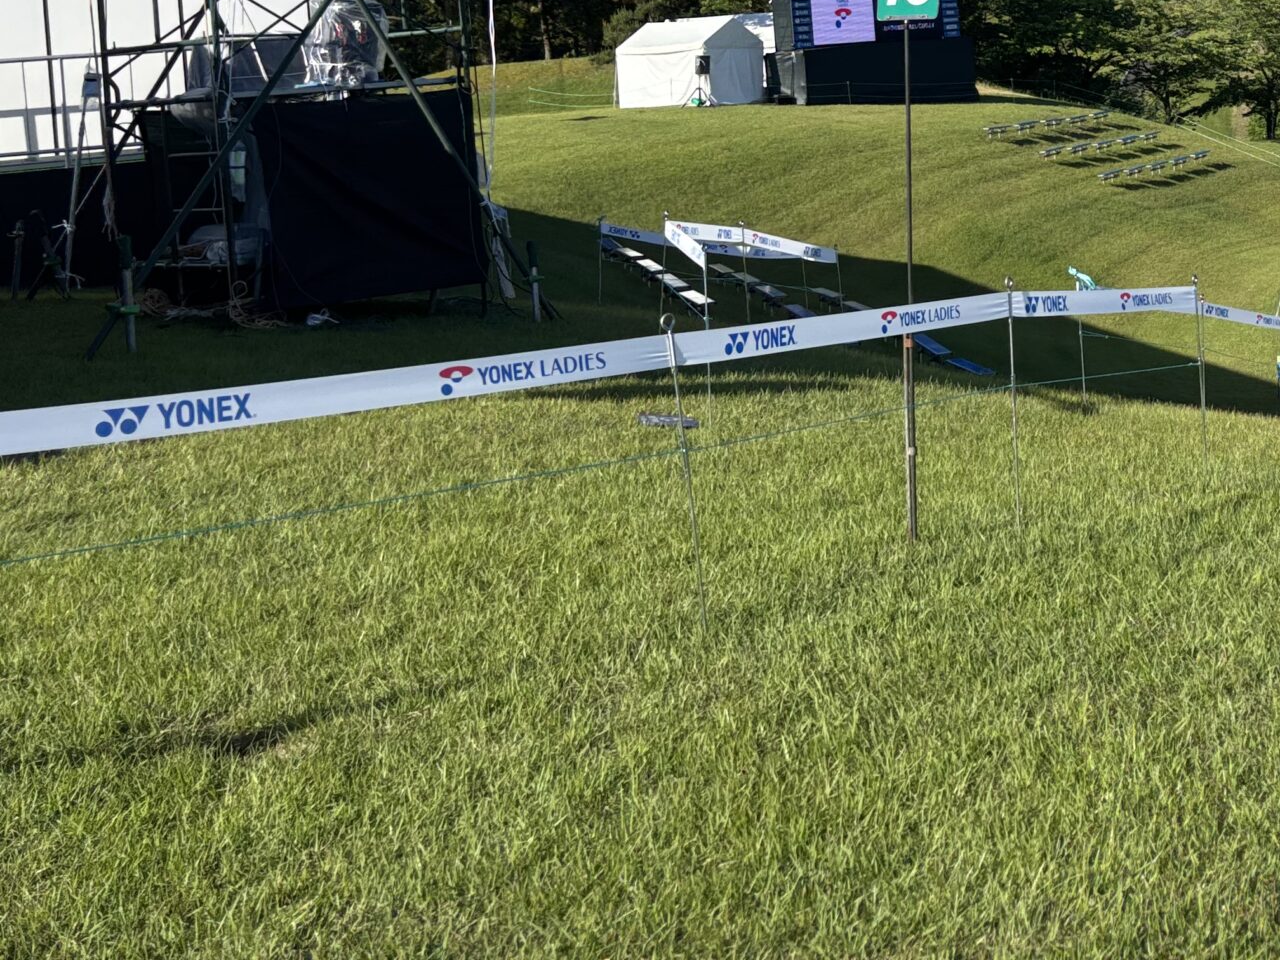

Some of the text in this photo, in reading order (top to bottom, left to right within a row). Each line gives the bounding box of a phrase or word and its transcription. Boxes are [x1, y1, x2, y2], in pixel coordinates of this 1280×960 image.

[1041, 295, 1067, 312] YONEX
[1132, 293, 1173, 307] YONEX LADIES
[899, 304, 960, 327] YONEX LADIES
[1214, 307, 1229, 318] YONEX
[753, 325, 796, 350] YONEX
[477, 351, 607, 385] YONEX LADIES
[157, 393, 251, 429] YONEX
